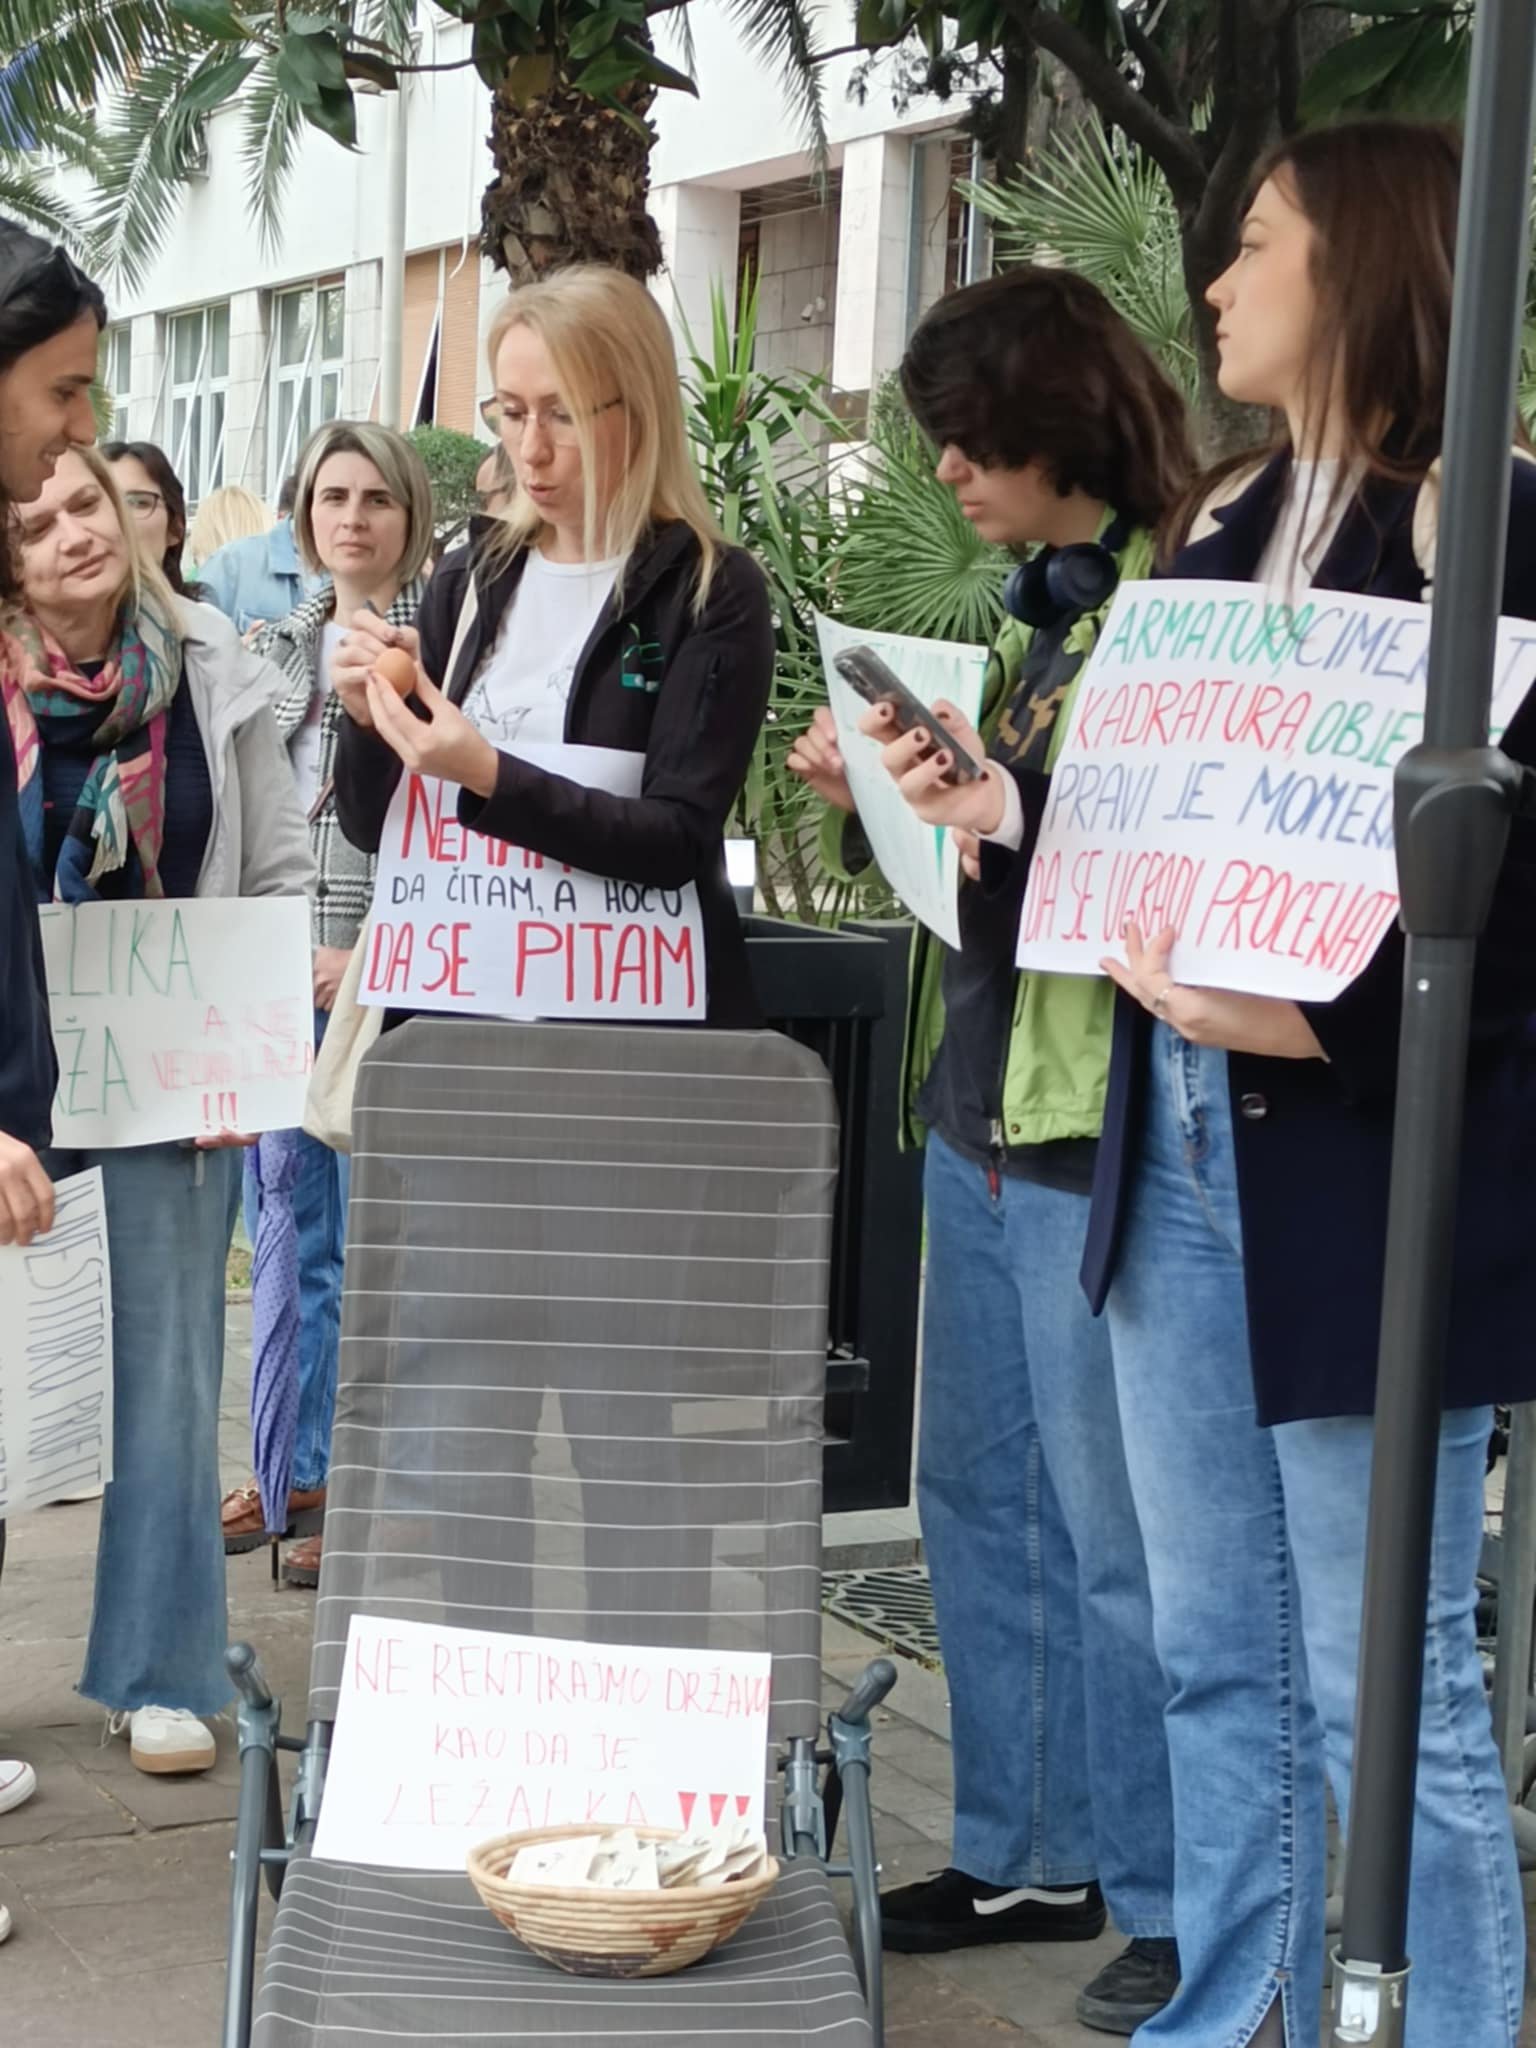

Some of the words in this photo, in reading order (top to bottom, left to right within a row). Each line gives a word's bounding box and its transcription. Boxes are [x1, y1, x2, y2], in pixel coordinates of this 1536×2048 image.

[1048, 762, 1158, 832] PRAVI
[1161, 761, 1225, 820] JE
[391, 876, 425, 904] DA
[445, 865, 544, 917] ČITAM,
[554, 879, 577, 912] A
[1024, 850, 1061, 943] DA
[1061, 850, 1103, 940] SE
[367, 921, 414, 993] DA
[421, 922, 476, 997] SE
[515, 920, 695, 1008] PITAM
[25, 1390, 104, 1499] PROFIT
[354, 1637, 409, 1695] NE
[431, 1643, 651, 1704] RENTIRAJMO
[434, 1722, 505, 1760] KAO
[525, 1733, 568, 1765] DA
[594, 1733, 639, 1770] JE
